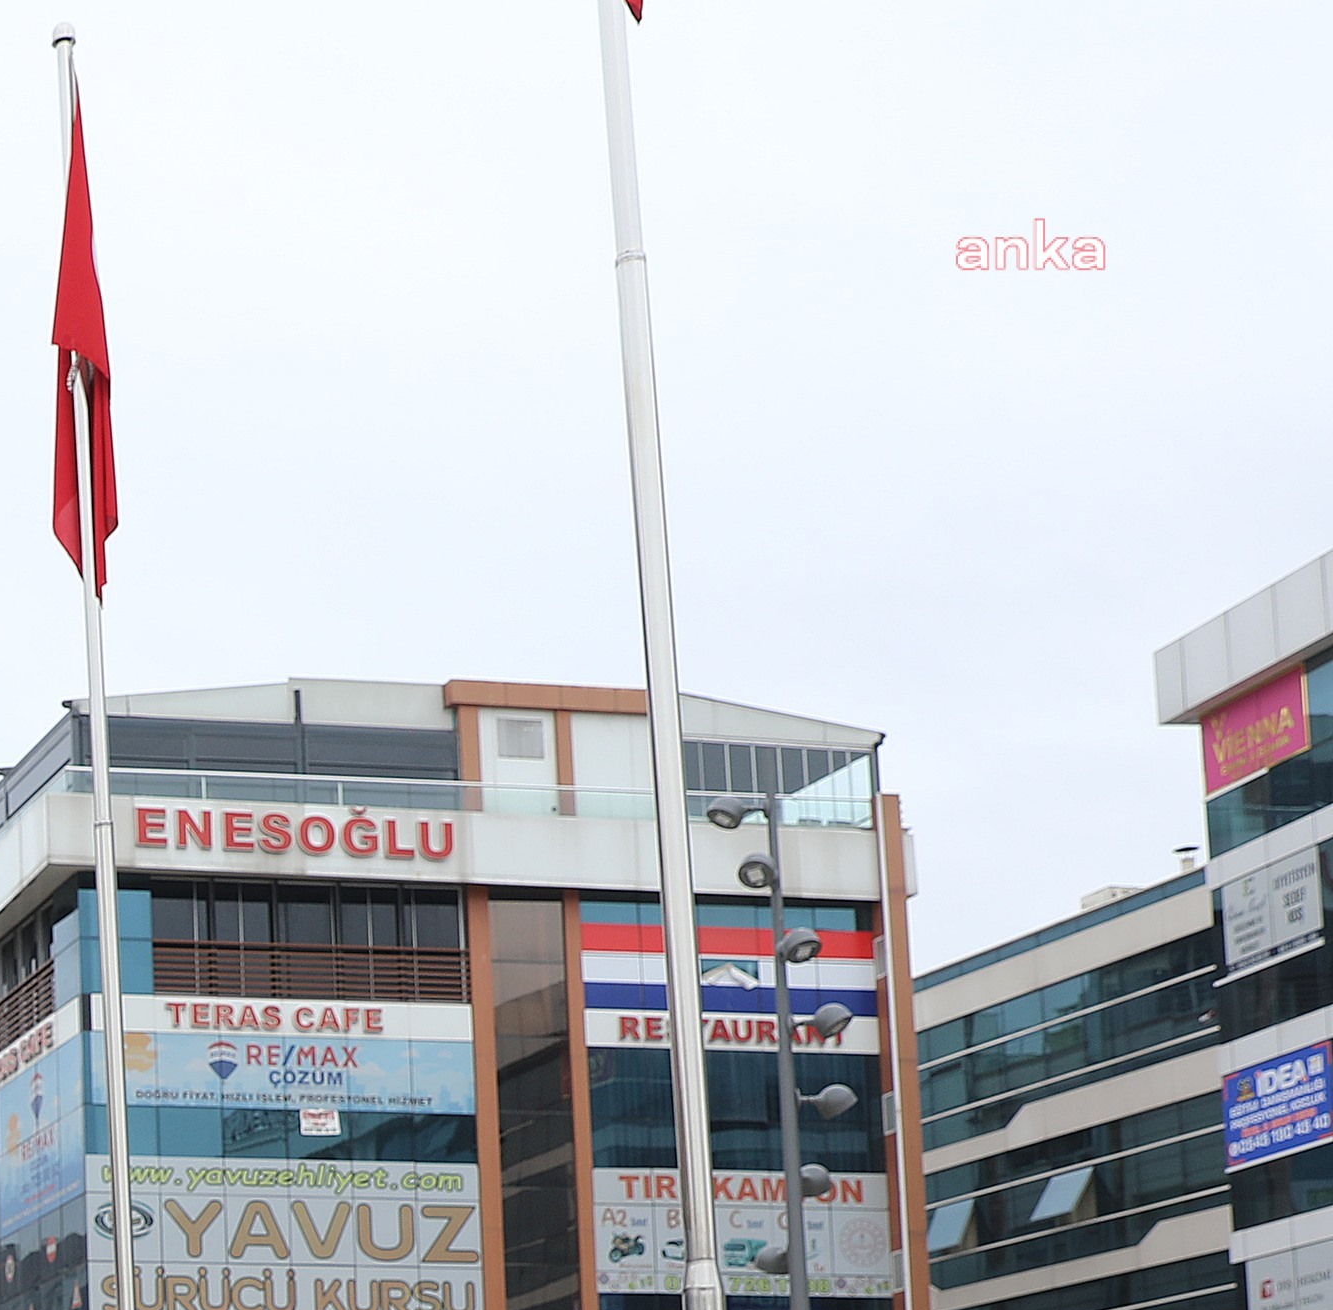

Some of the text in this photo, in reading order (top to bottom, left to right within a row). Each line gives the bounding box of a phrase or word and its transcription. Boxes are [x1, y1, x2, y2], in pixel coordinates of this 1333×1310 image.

[135, 804, 455, 861] ENESOĞLU
[165, 1001, 385, 1034] TERAS CAFE
[245, 1043, 361, 1069] RE/MAX
[269, 1067, 344, 1088] ÇÖZÜM
[618, 1174, 677, 1199] TIR
[164, 1198, 480, 1263] YAVUZ
